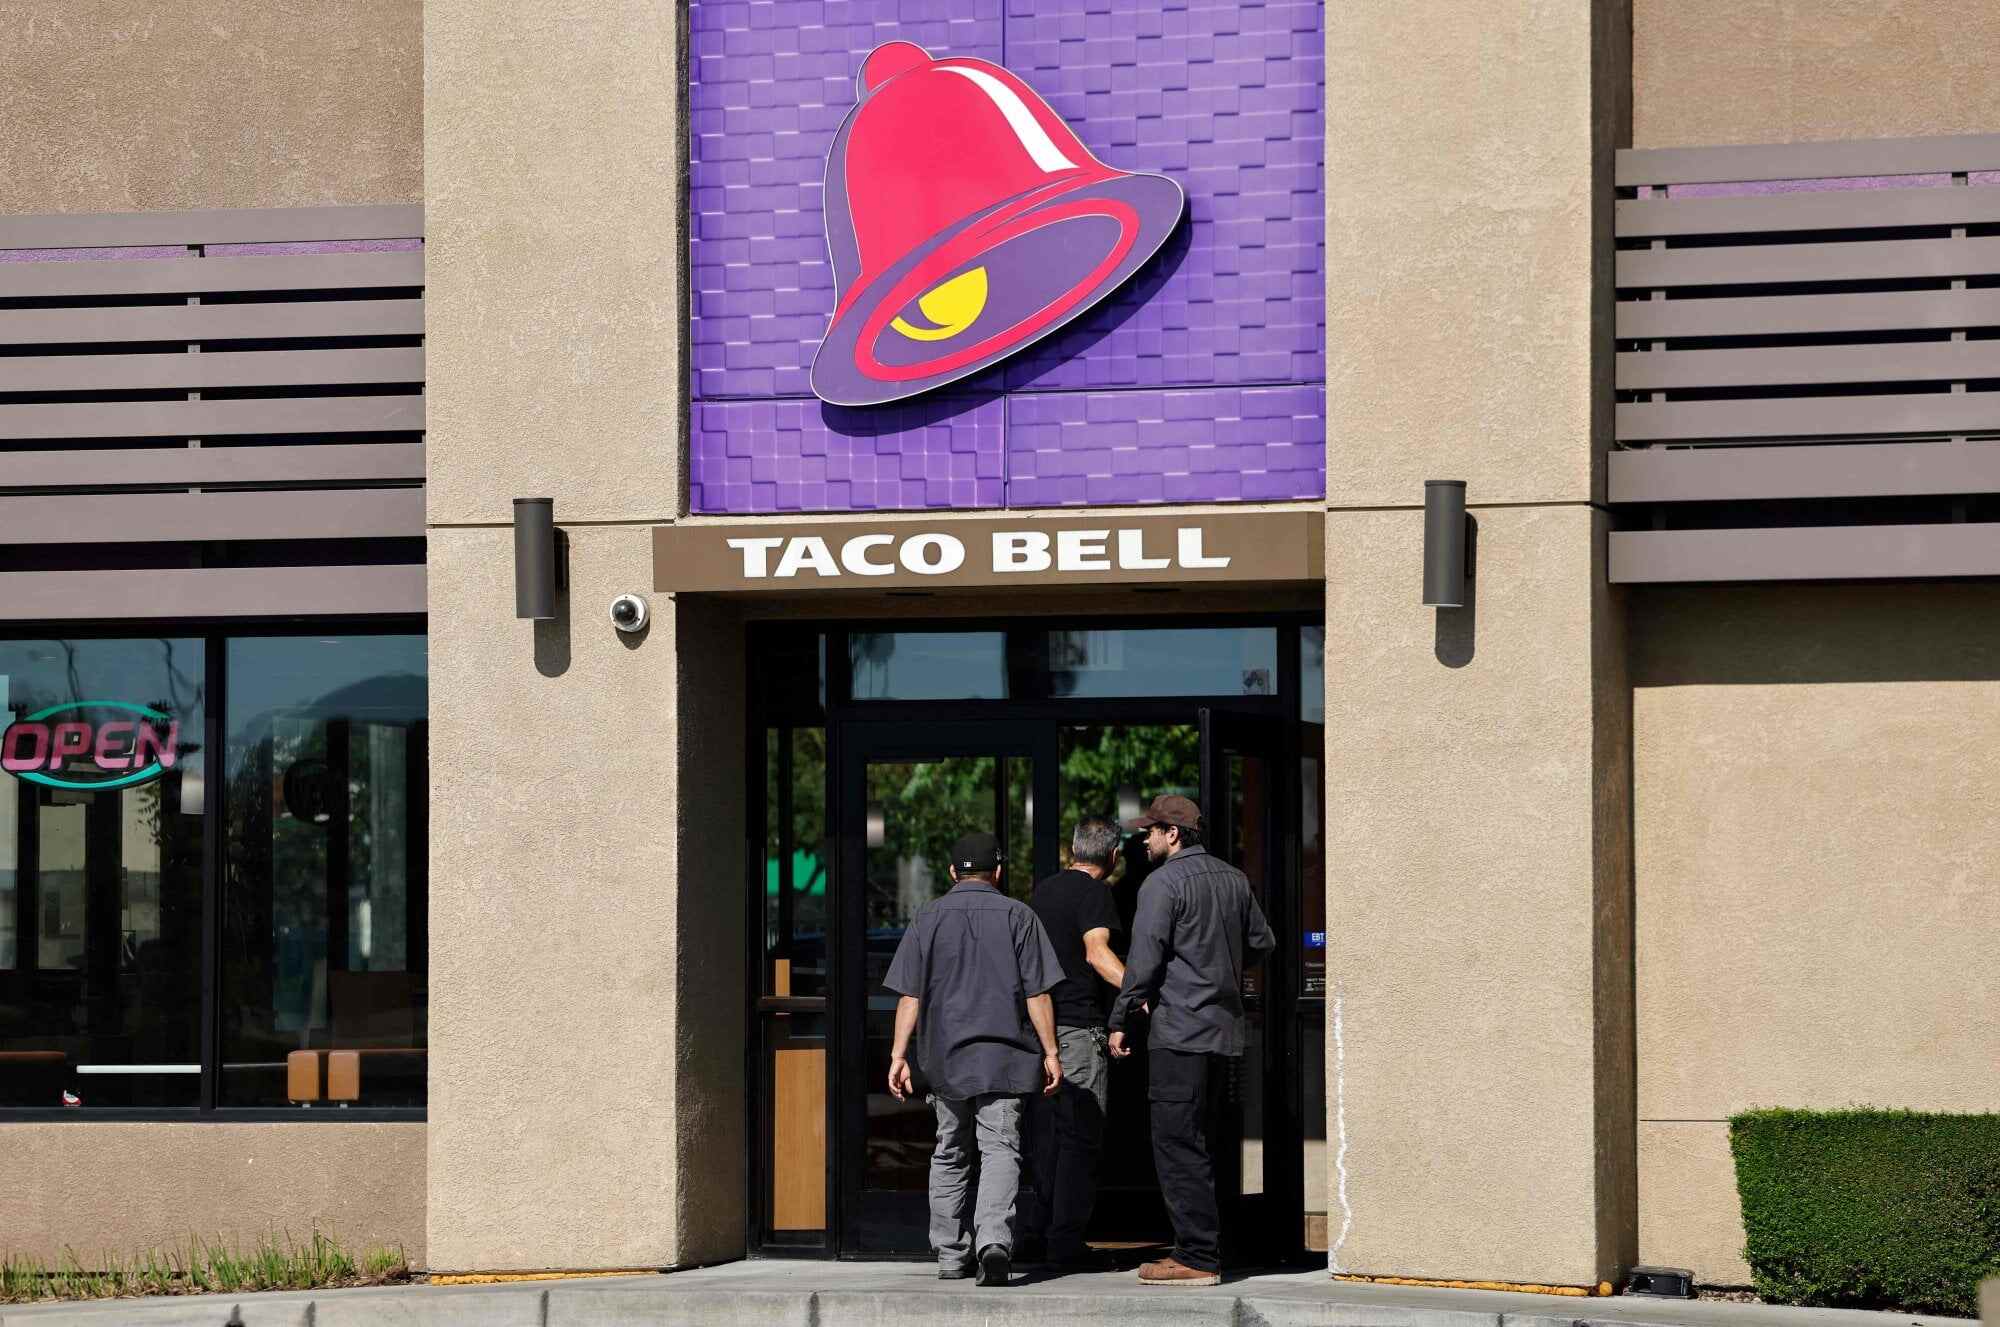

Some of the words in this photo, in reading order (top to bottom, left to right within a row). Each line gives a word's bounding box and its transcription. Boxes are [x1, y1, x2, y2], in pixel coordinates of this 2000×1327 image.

[726, 533, 966, 578] TACO
[992, 527, 1232, 572] BELL
[2, 719, 179, 771] OPEN
